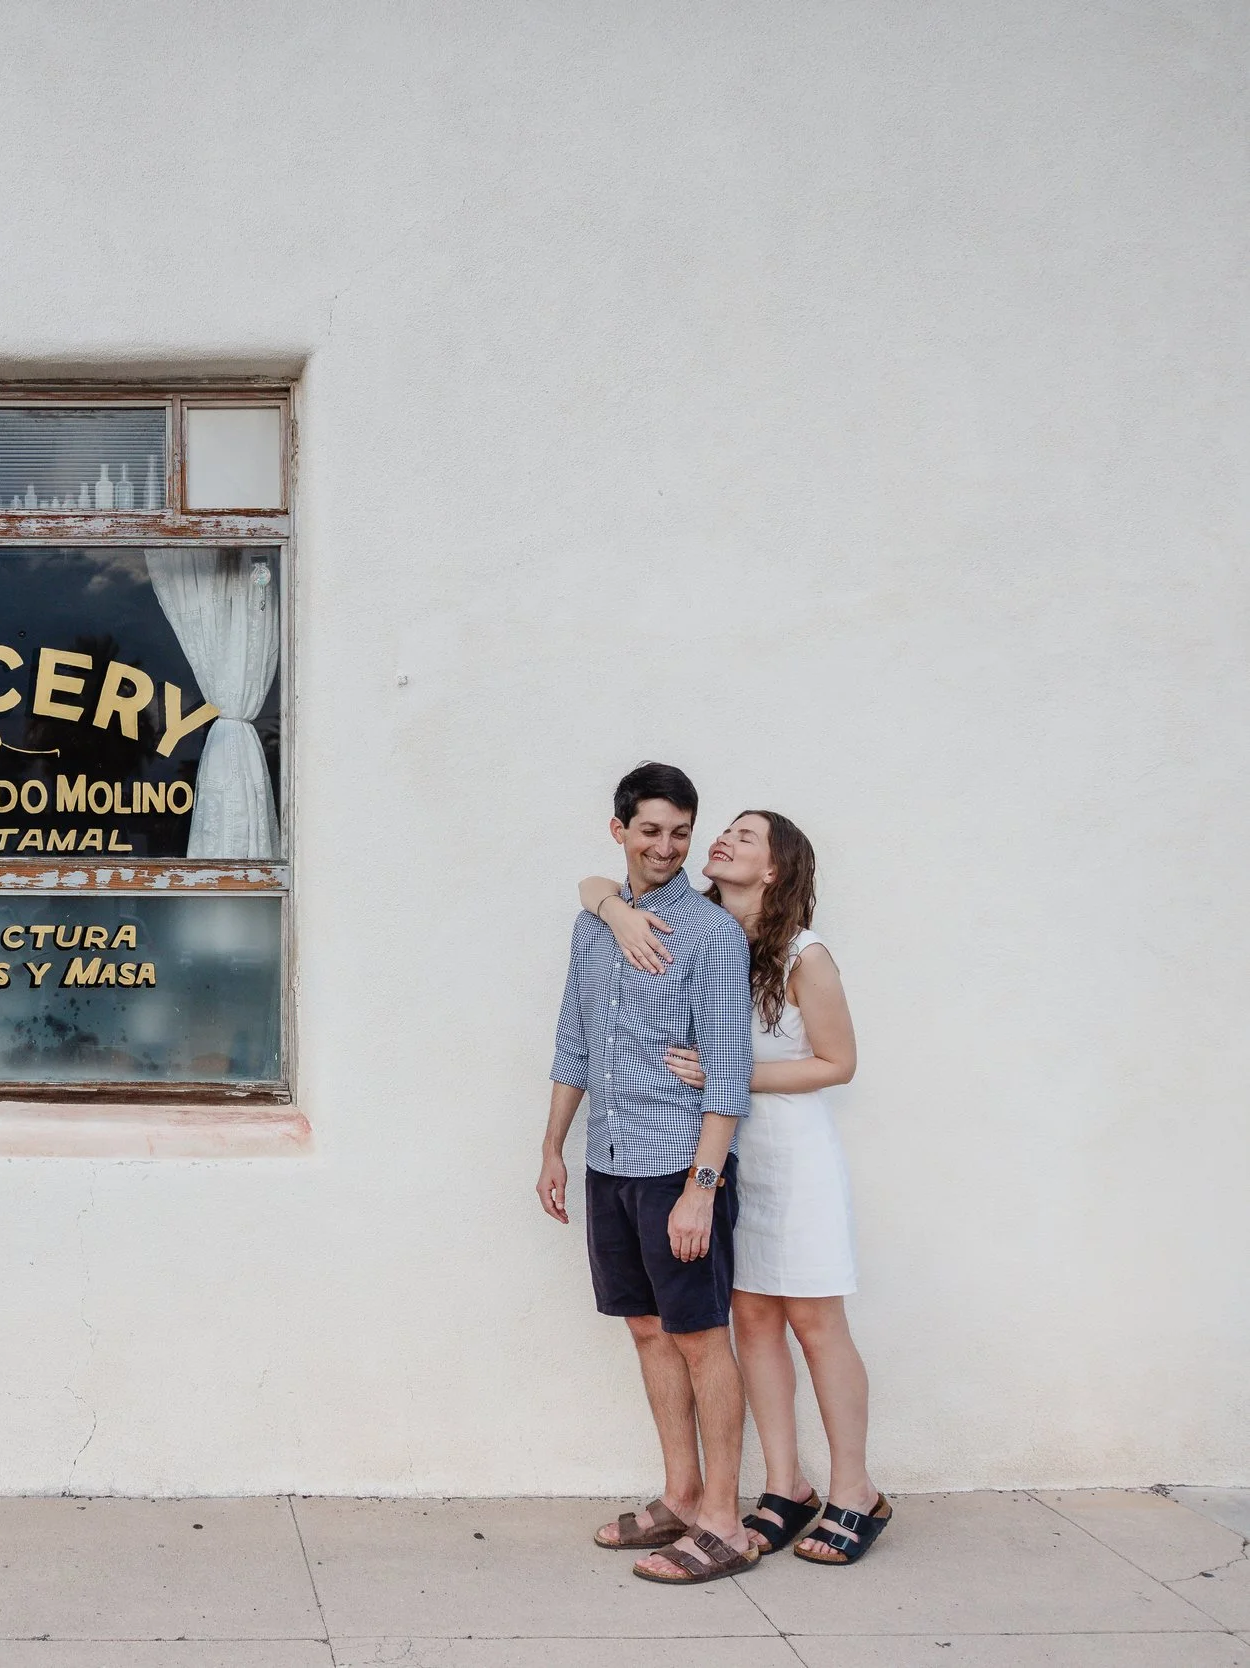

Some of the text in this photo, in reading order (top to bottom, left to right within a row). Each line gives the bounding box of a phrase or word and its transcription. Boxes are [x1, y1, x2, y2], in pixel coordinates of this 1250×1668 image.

[56, 774, 193, 814] MOLINO
[28, 963, 50, 984] Y
[65, 957, 156, 985] MASA
